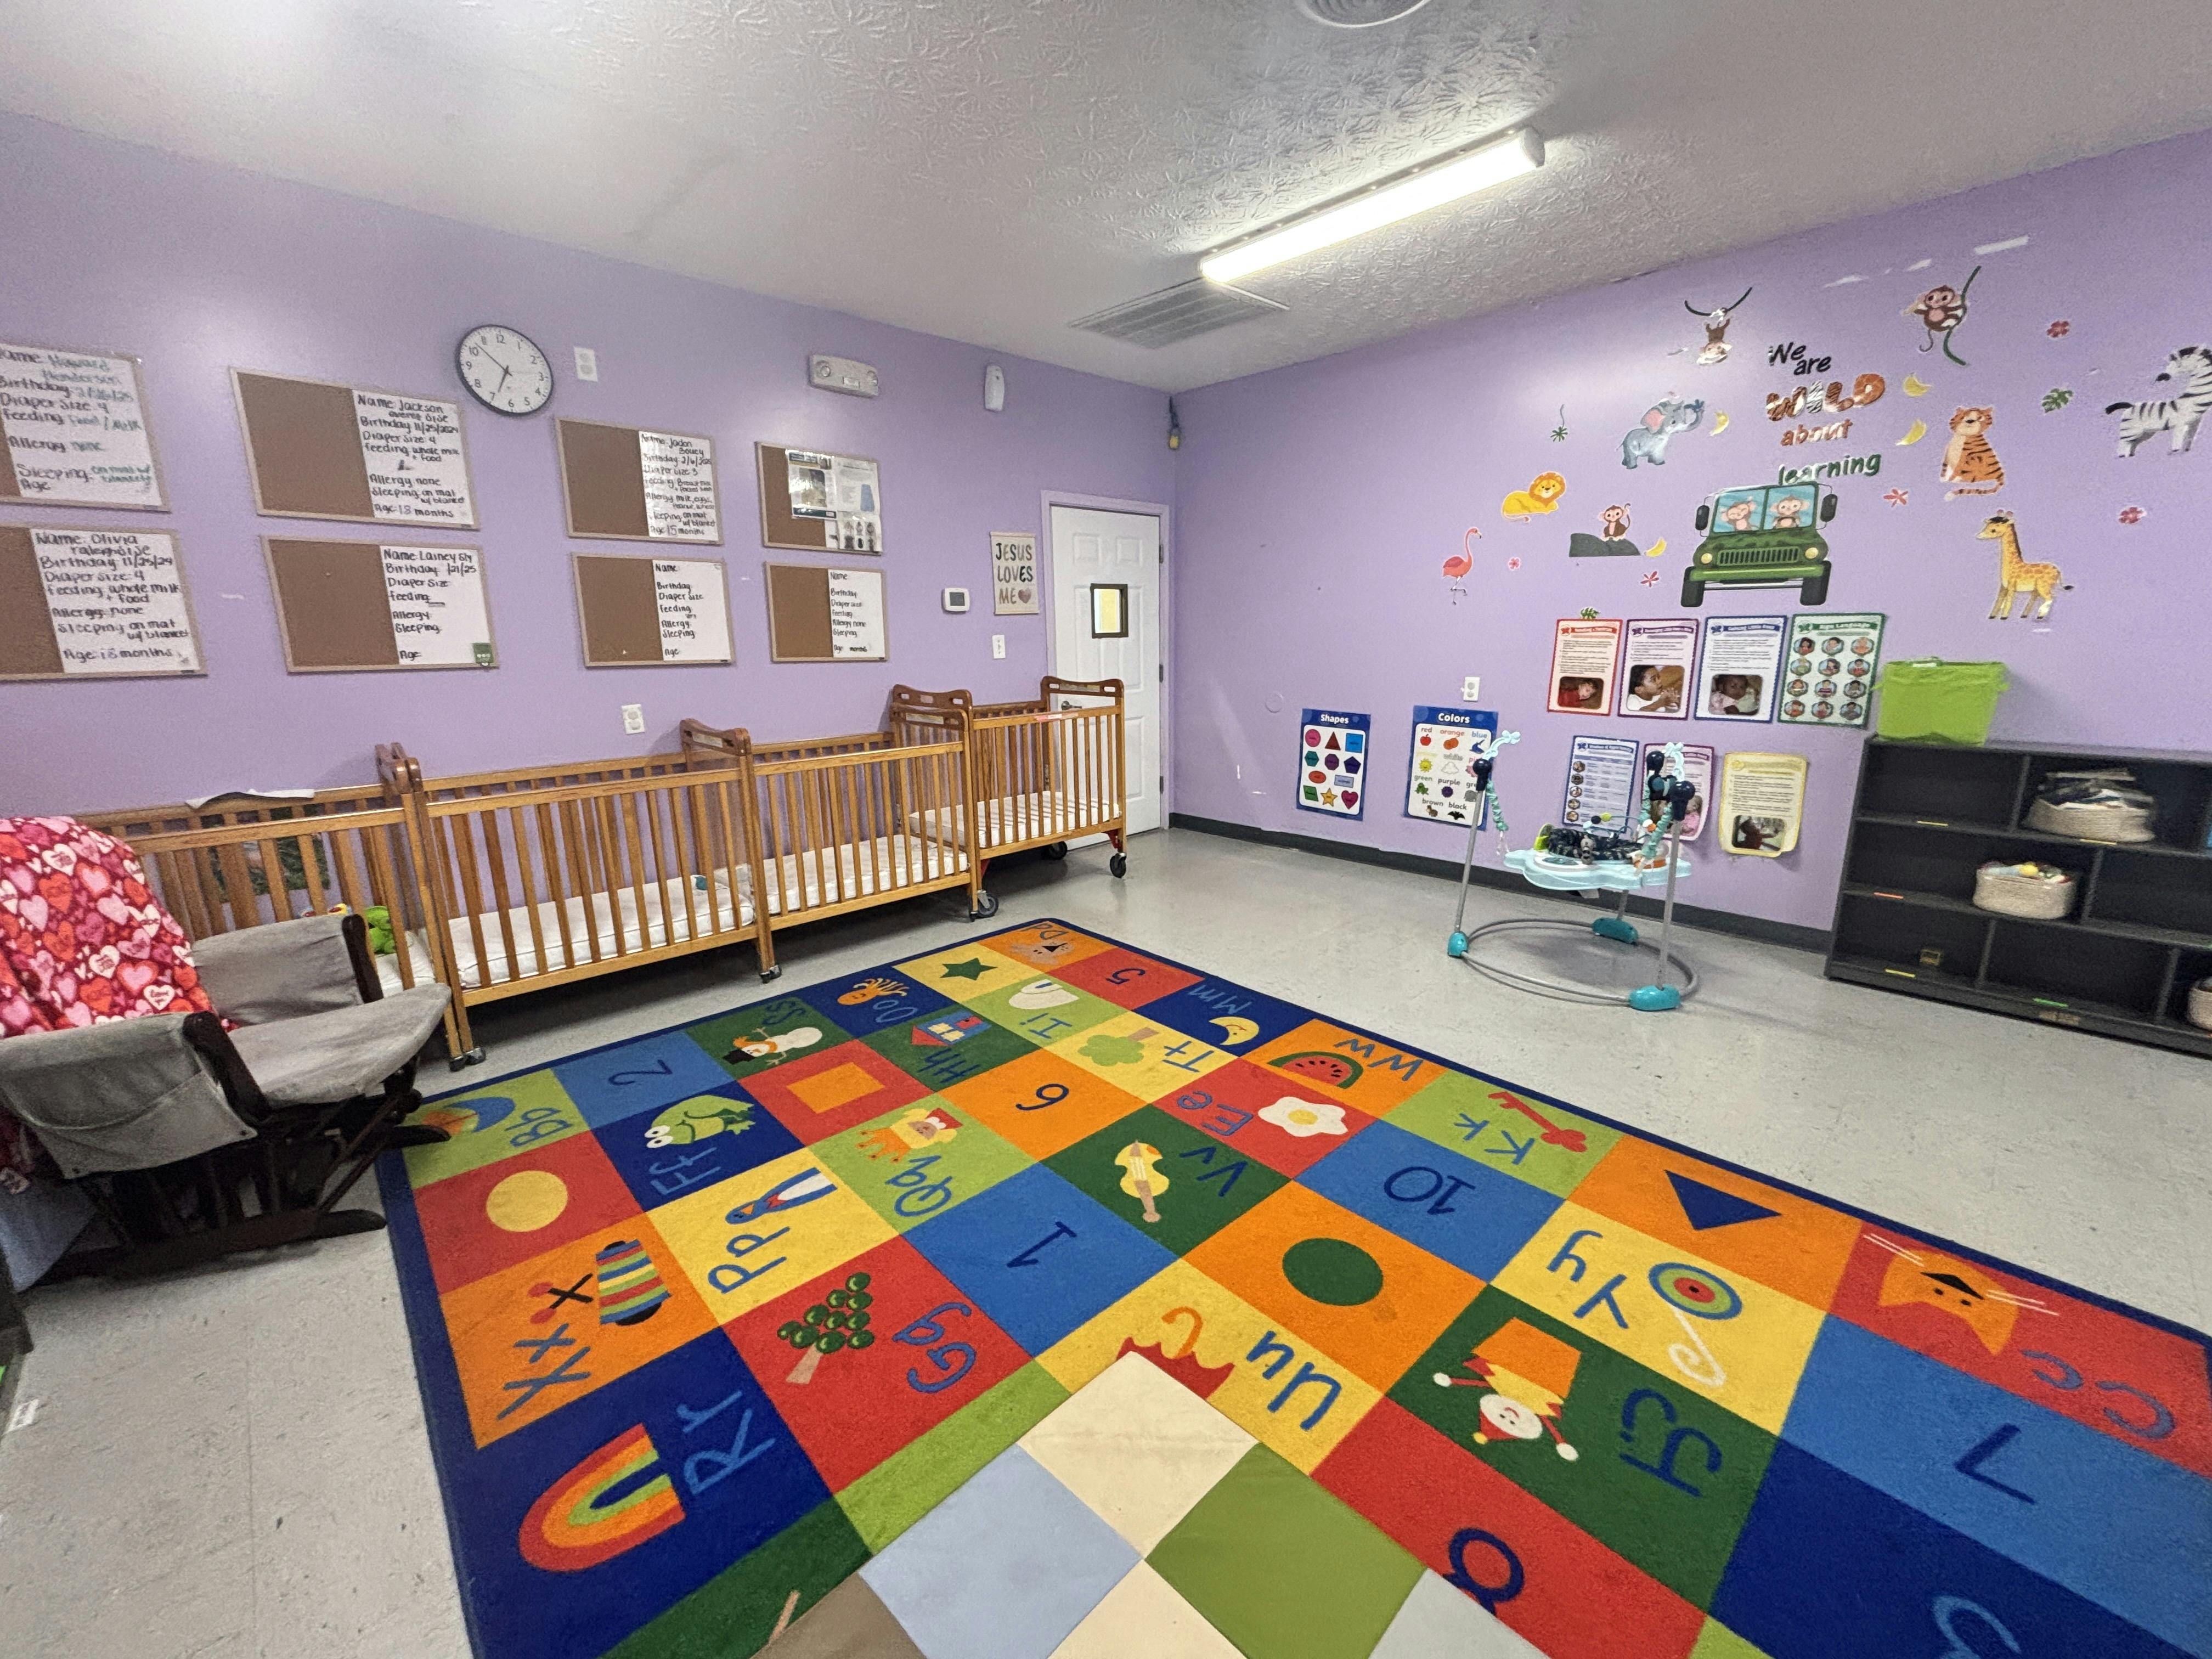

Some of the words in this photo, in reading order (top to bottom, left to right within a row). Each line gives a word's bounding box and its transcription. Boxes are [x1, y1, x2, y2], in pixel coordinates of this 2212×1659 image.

[496, 335, 505, 343] 12
[517, 341, 521, 351] 1
[469, 346, 479, 356] 10
[531, 356, 538, 364] 2
[1769, 342, 1807, 366] We
[466, 361, 472, 370] 9
[1793, 356, 1832, 375] are
[475, 379, 482, 388] 8
[539, 373, 544, 381] 3
[490, 392, 495, 400] 7
[535, 387, 541, 395] 4
[399, 400, 443, 413] Jackson
[508, 399, 514, 408] 6
[524, 397, 530, 405] 5
[1780, 418, 1853, 446] about
[1778, 454, 1882, 486] learning
[996, 543, 1032, 561] JESUS
[997, 566, 1034, 584] LOVES
[999, 588, 1017, 605] ME
[1321, 714, 1349, 724] Shapes
[1438, 713, 1470, 724] Colors
[1438, 778, 1460, 786] purple
[1422, 798, 1443, 806] brown
[1448, 802, 1467, 811] black
[1106, 967, 1146, 985] 5
[1163, 1040, 1215, 1072] Tt
[608, 1059, 673, 1085] 2
[1177, 1091, 1254, 1136] Ee
[504, 1107, 574, 1148] Bb
[1454, 1113, 1535, 1166] Kk
[650, 1147, 721, 1195] Ff
[1180, 1146, 1248, 1198] Vv
[884, 1155, 953, 1217] Qq
[1384, 1166, 1475, 1216] 10
[1007, 1221, 1077, 1268] 1
[708, 1227, 791, 1294] Pp
[1546, 1229, 1630, 1330] Yy
[893, 1302, 977, 1393] Gg
[1246, 1330, 1342, 1432] Uu
[2020, 1349, 2176, 1441] Cc
[676, 1390, 777, 1496] Rr
[1619, 1387, 1724, 1498] Jj
